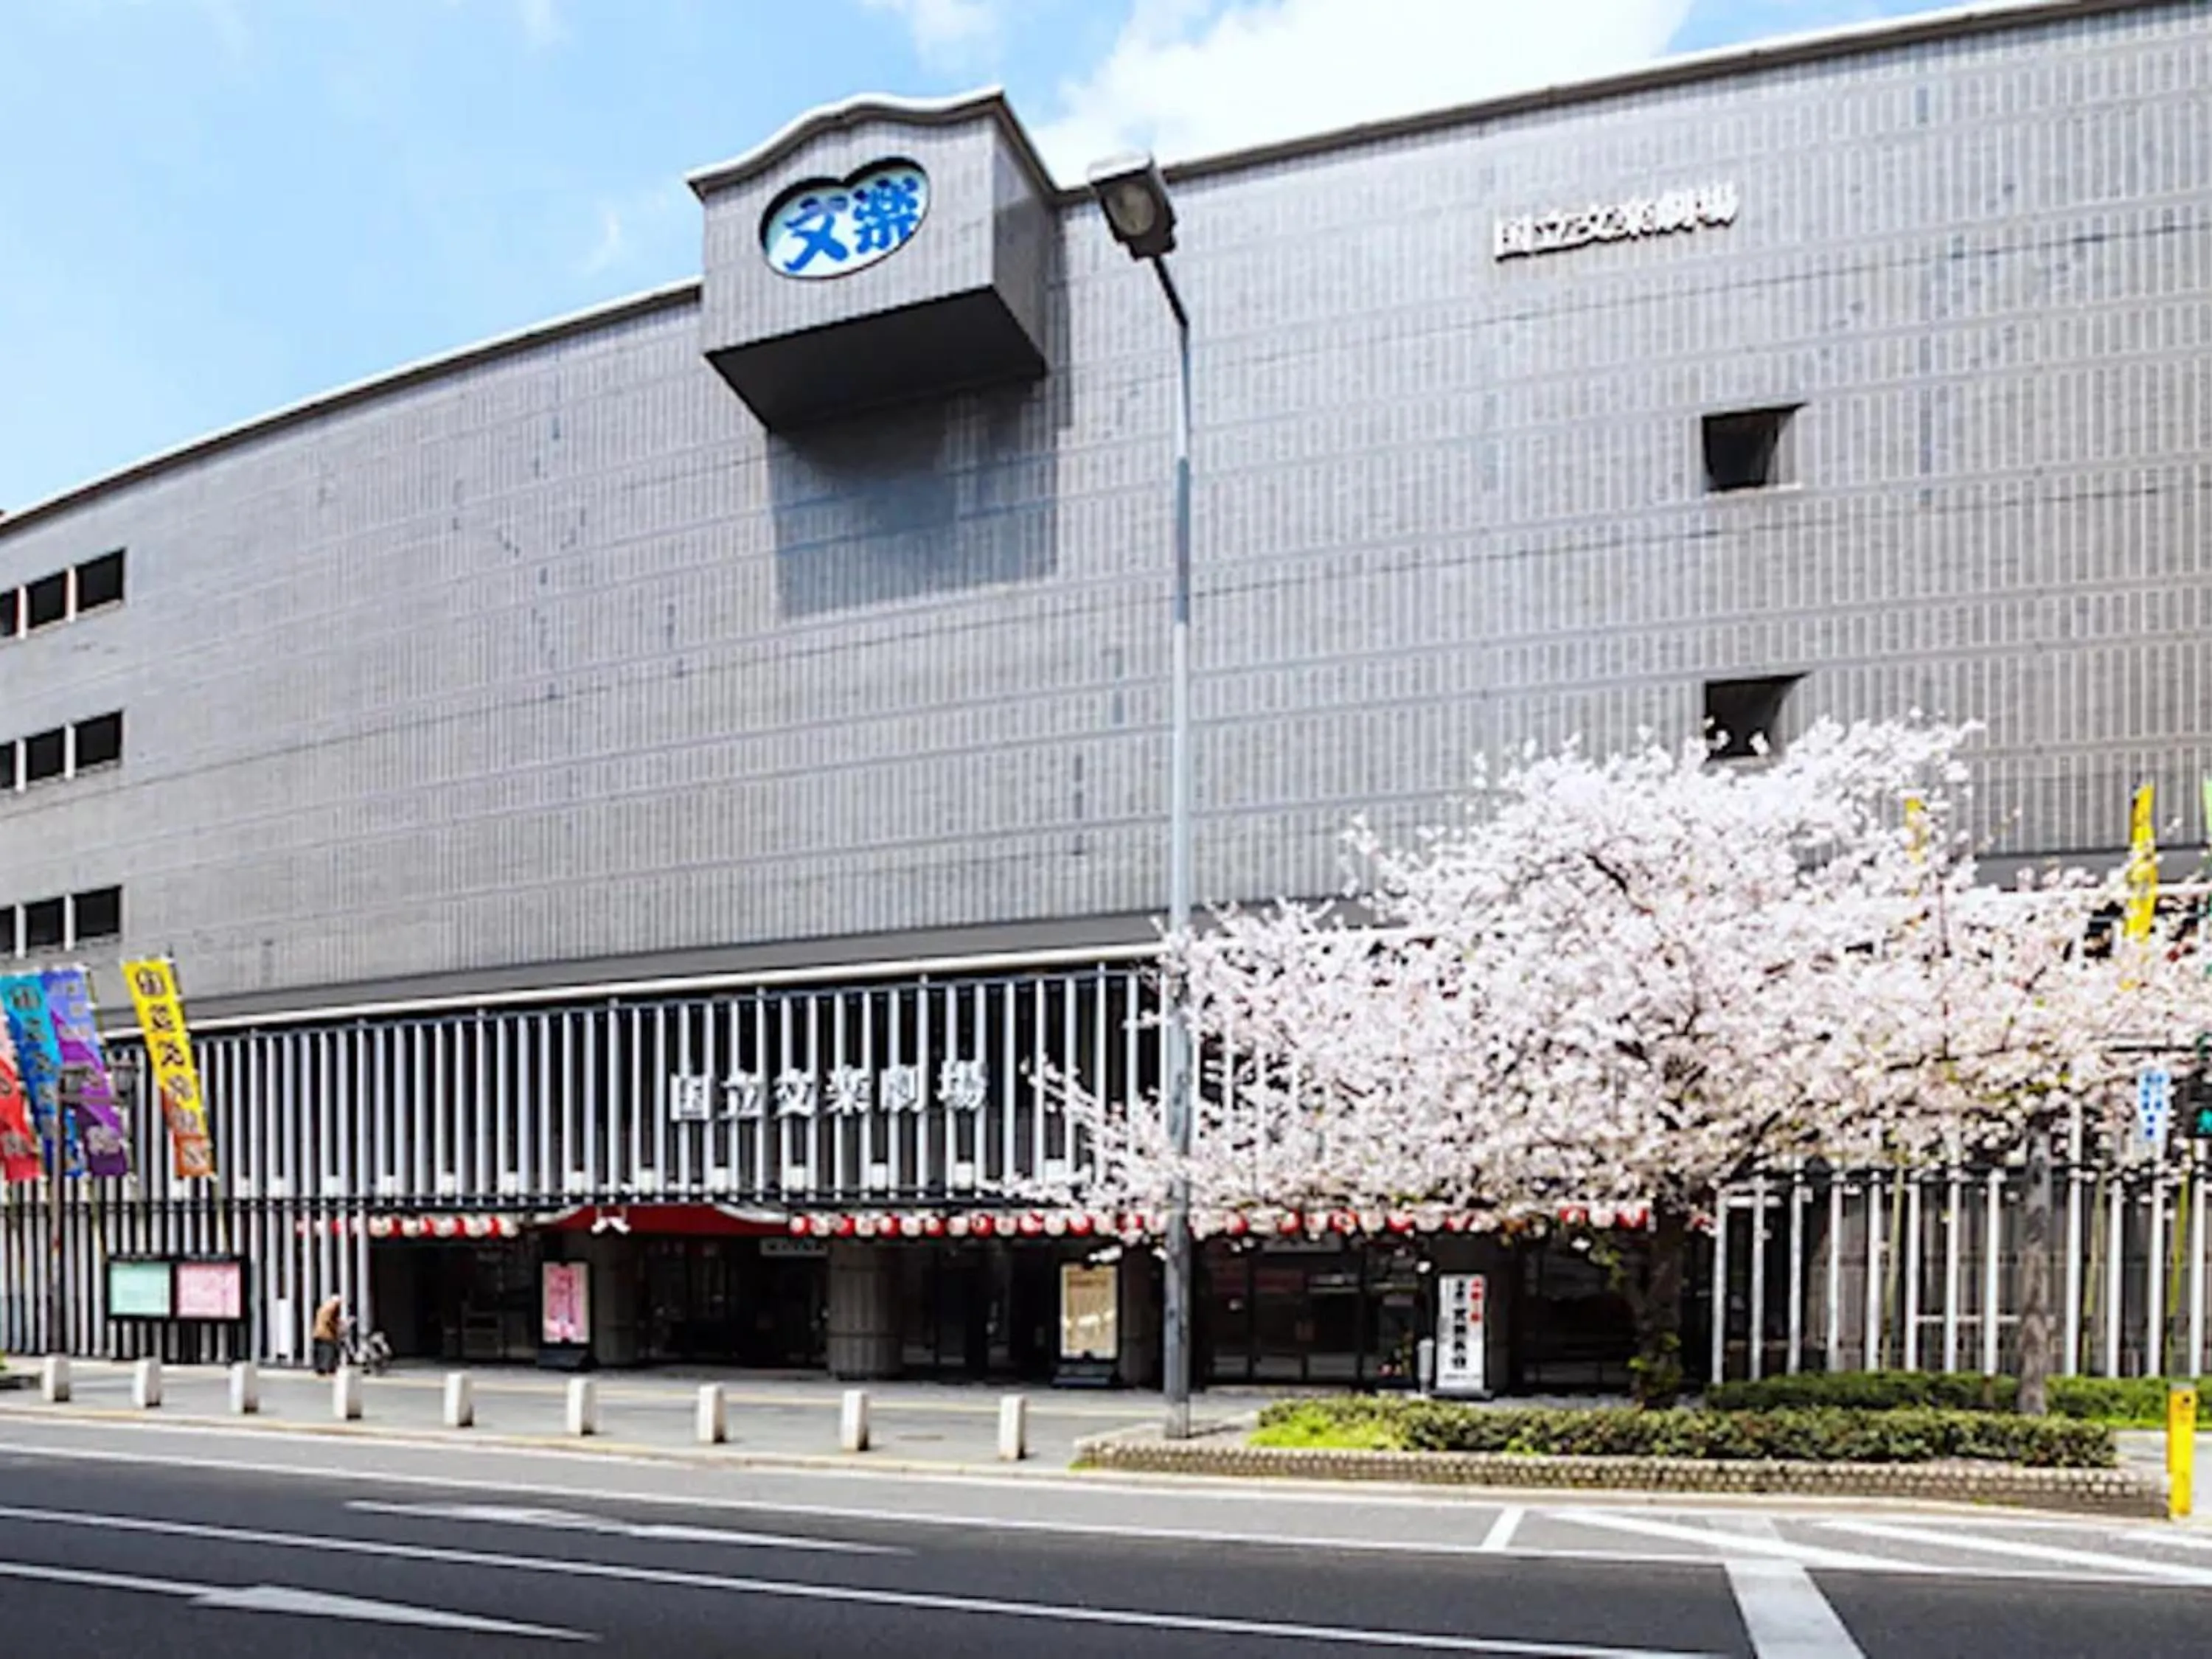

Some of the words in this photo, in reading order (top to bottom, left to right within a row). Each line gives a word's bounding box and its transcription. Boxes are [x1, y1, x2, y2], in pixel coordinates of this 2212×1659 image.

[784, 177, 919, 271] 文楽
[669, 1060, 987, 1121] 国立文楽劇場
